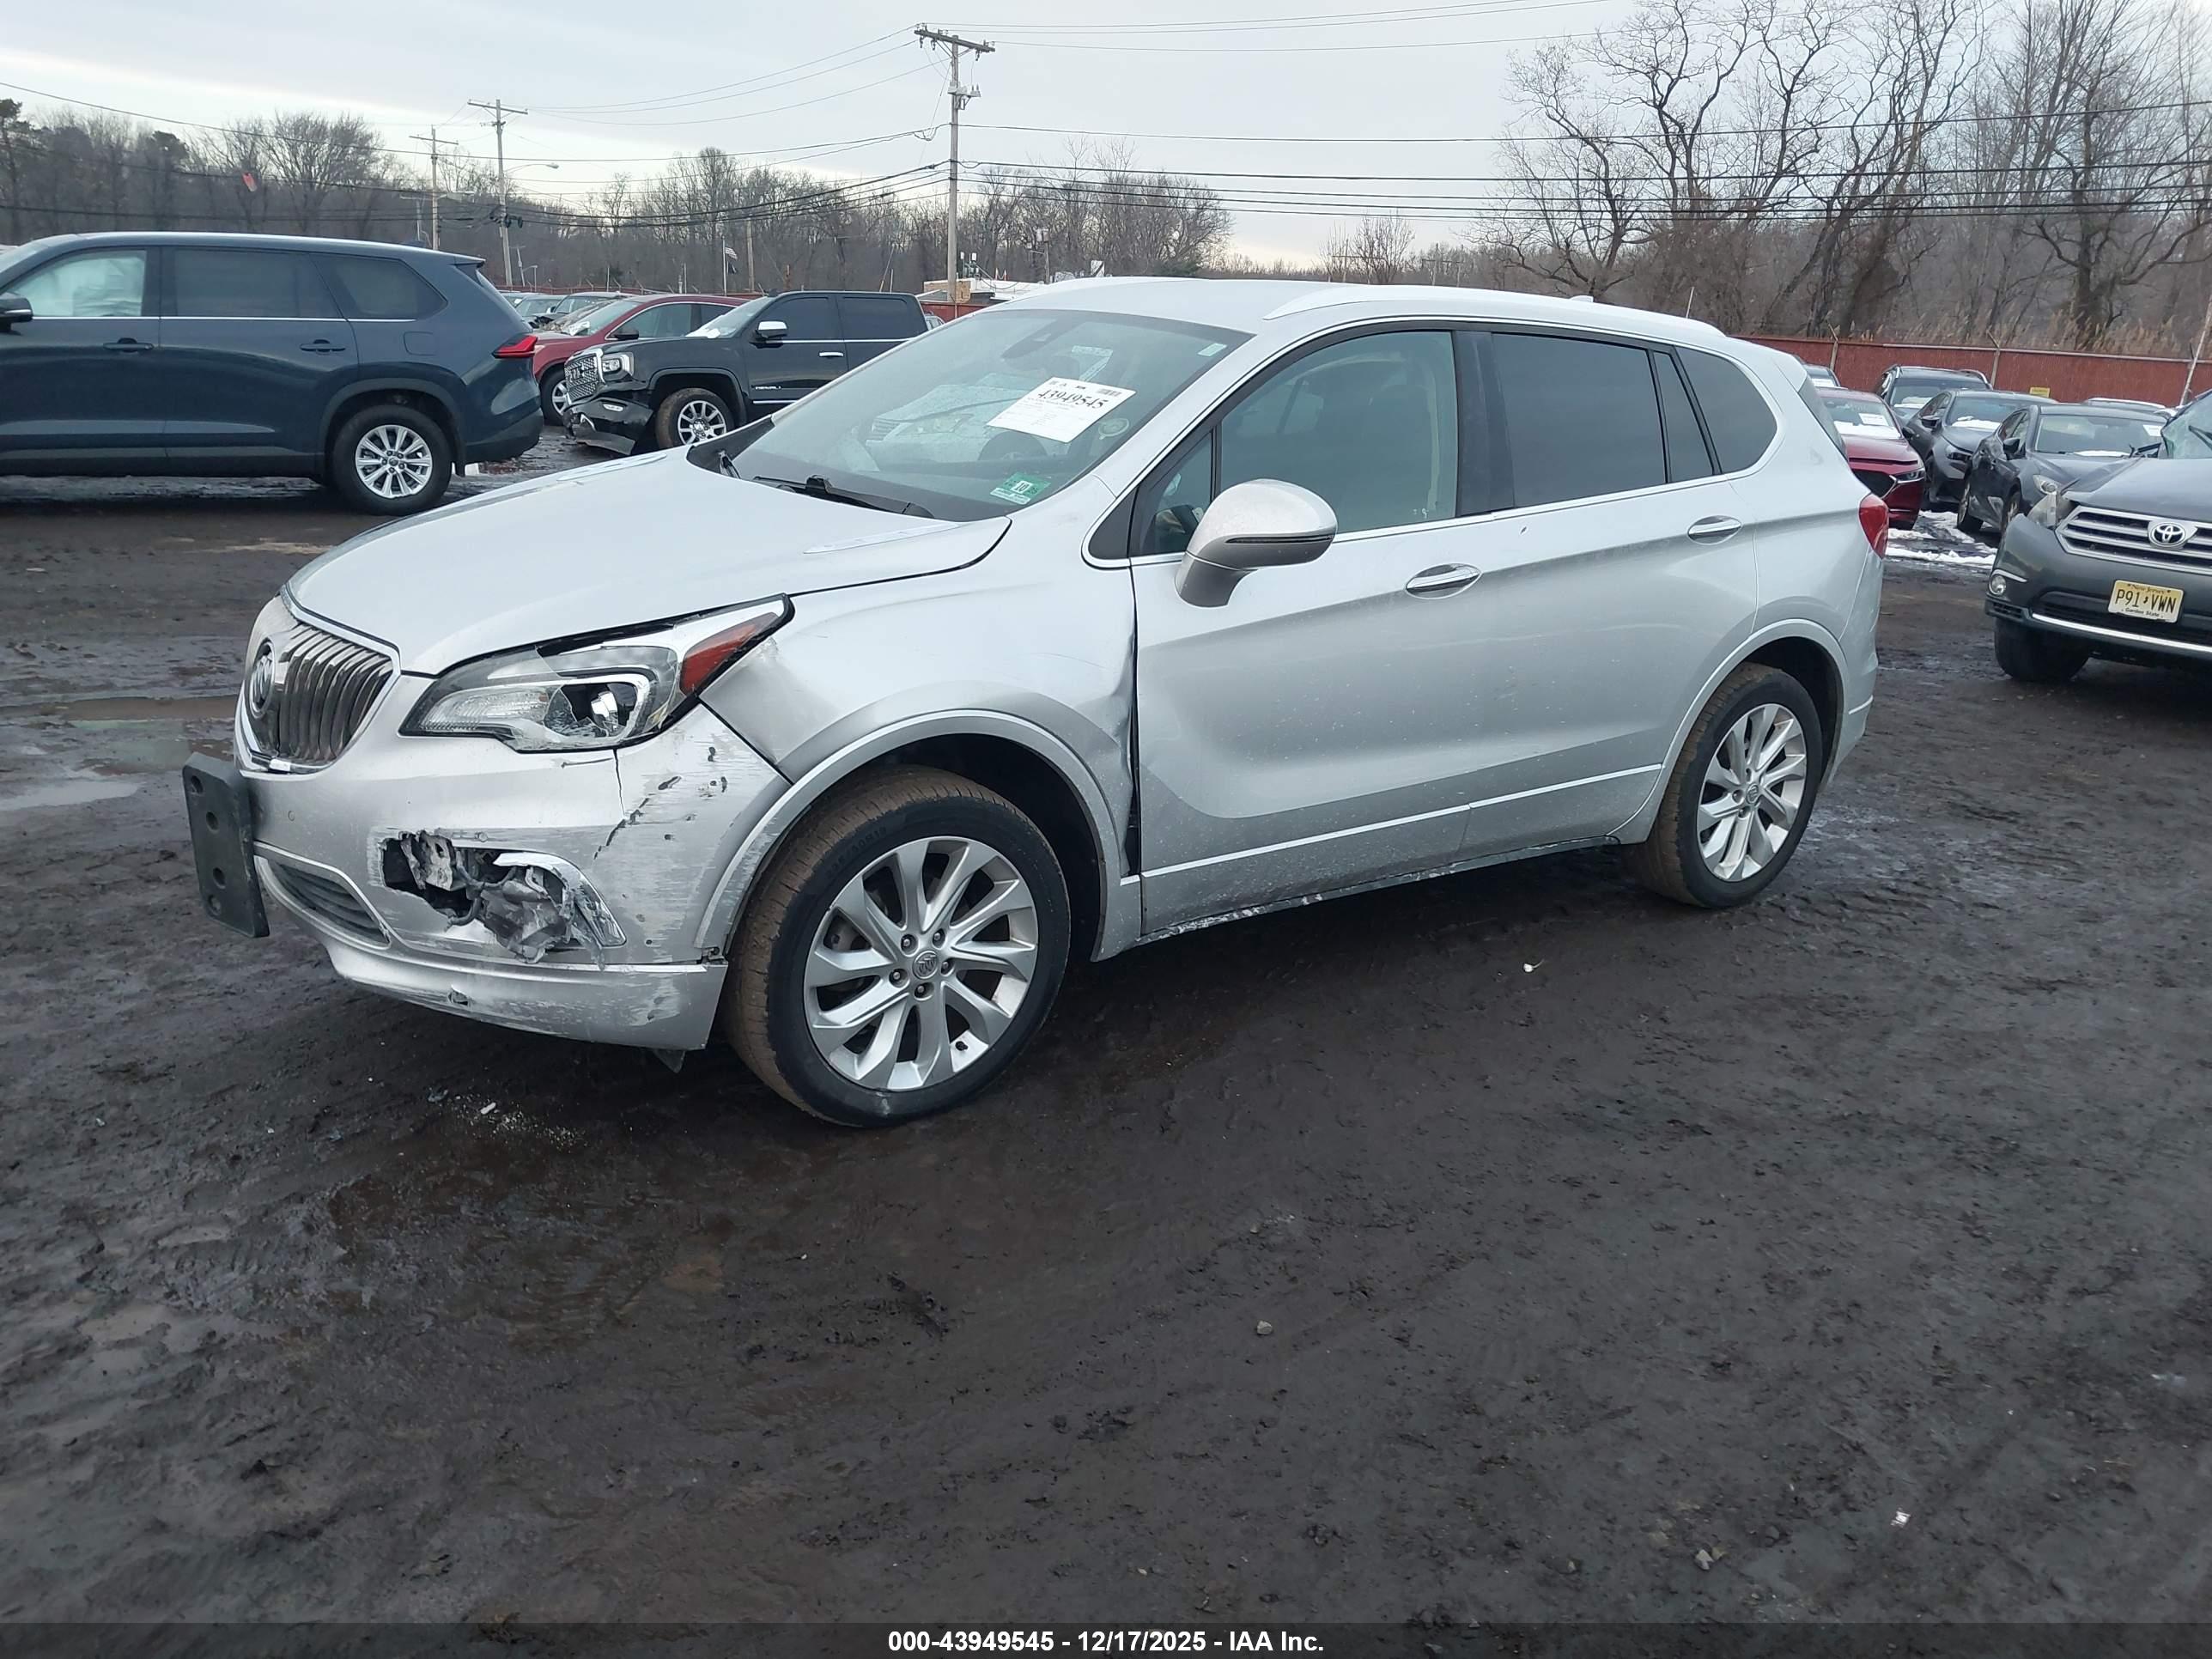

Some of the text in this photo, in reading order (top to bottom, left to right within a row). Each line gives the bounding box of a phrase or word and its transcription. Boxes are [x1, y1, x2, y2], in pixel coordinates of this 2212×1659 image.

[1038, 389, 1109, 409] 43949545
[2115, 589, 2177, 613] P91 VWN
